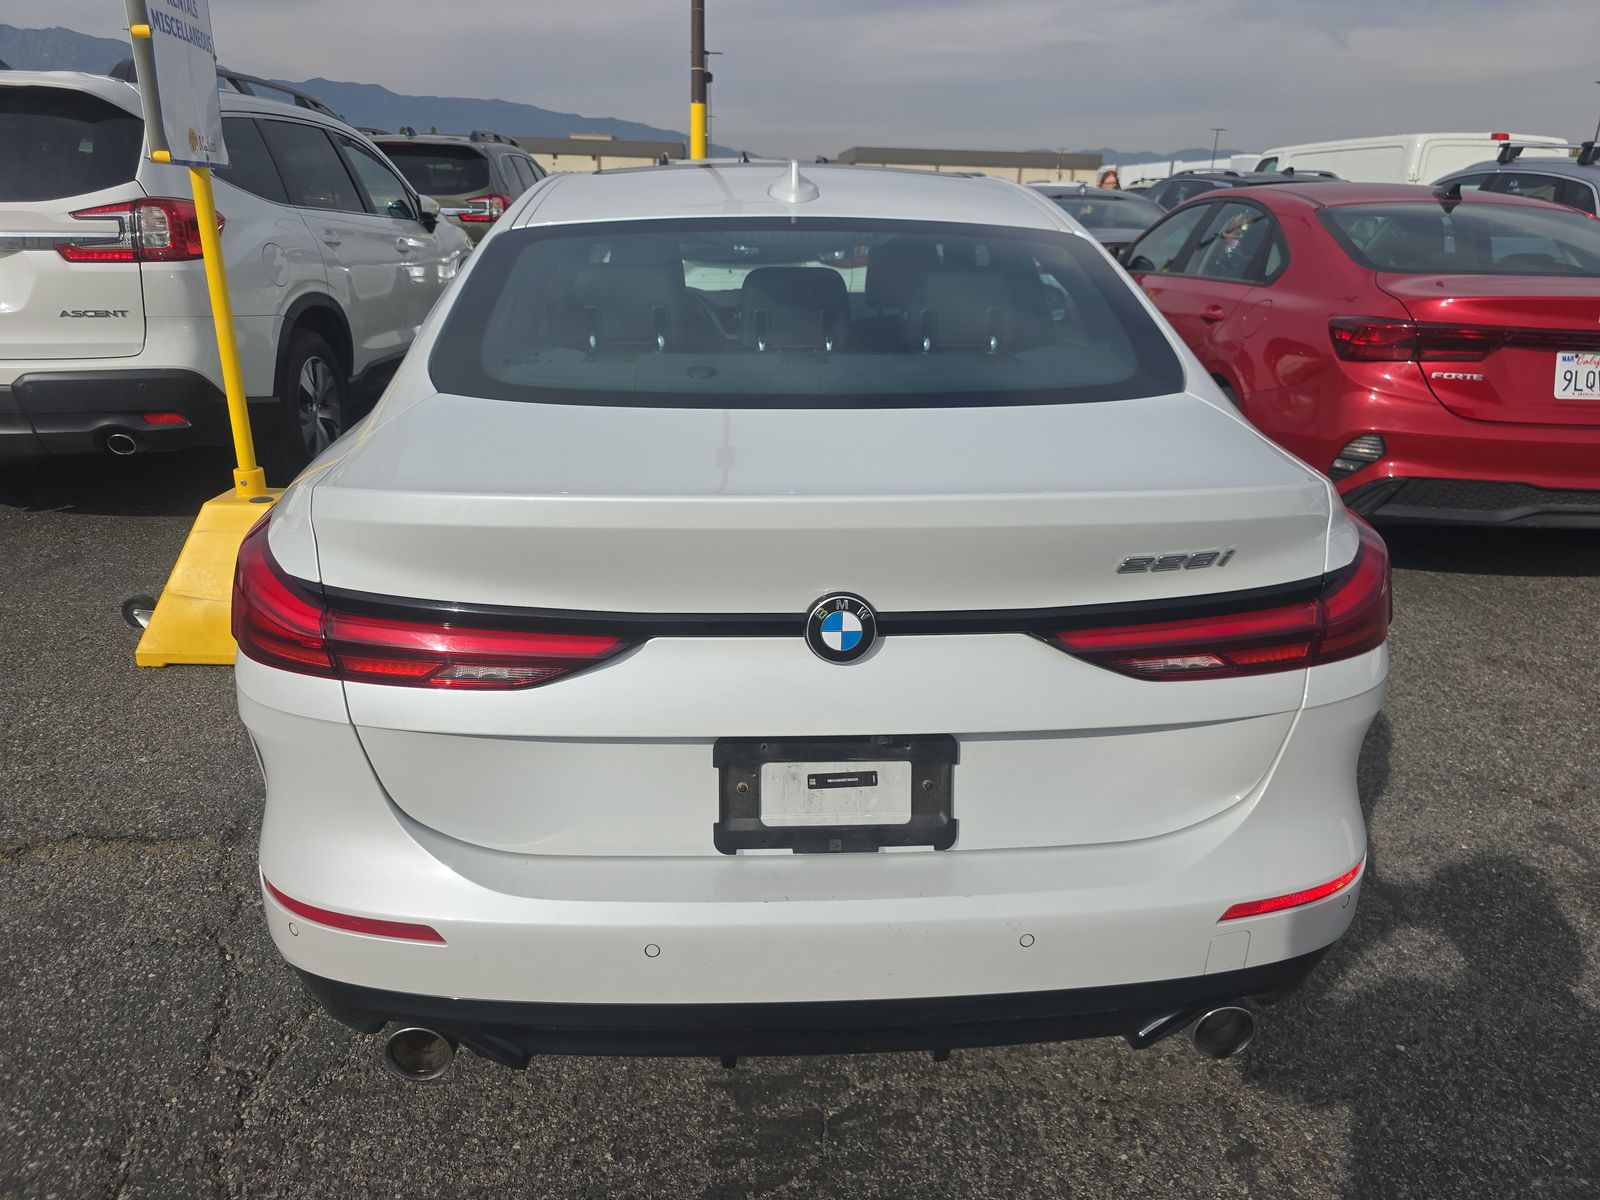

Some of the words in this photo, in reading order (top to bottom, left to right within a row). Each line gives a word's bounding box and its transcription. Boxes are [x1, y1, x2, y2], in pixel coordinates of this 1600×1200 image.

[166, 0, 198, 19] NTALS
[151, 8, 213, 54] MISCELLANEOUS
[59, 310, 129, 318] ASCENT
[1431, 371, 1484, 381] FORTE
[1562, 370, 1600, 392] 9LQ
[1116, 549, 1236, 575] 228i
[815, 599, 871, 621] BMW
